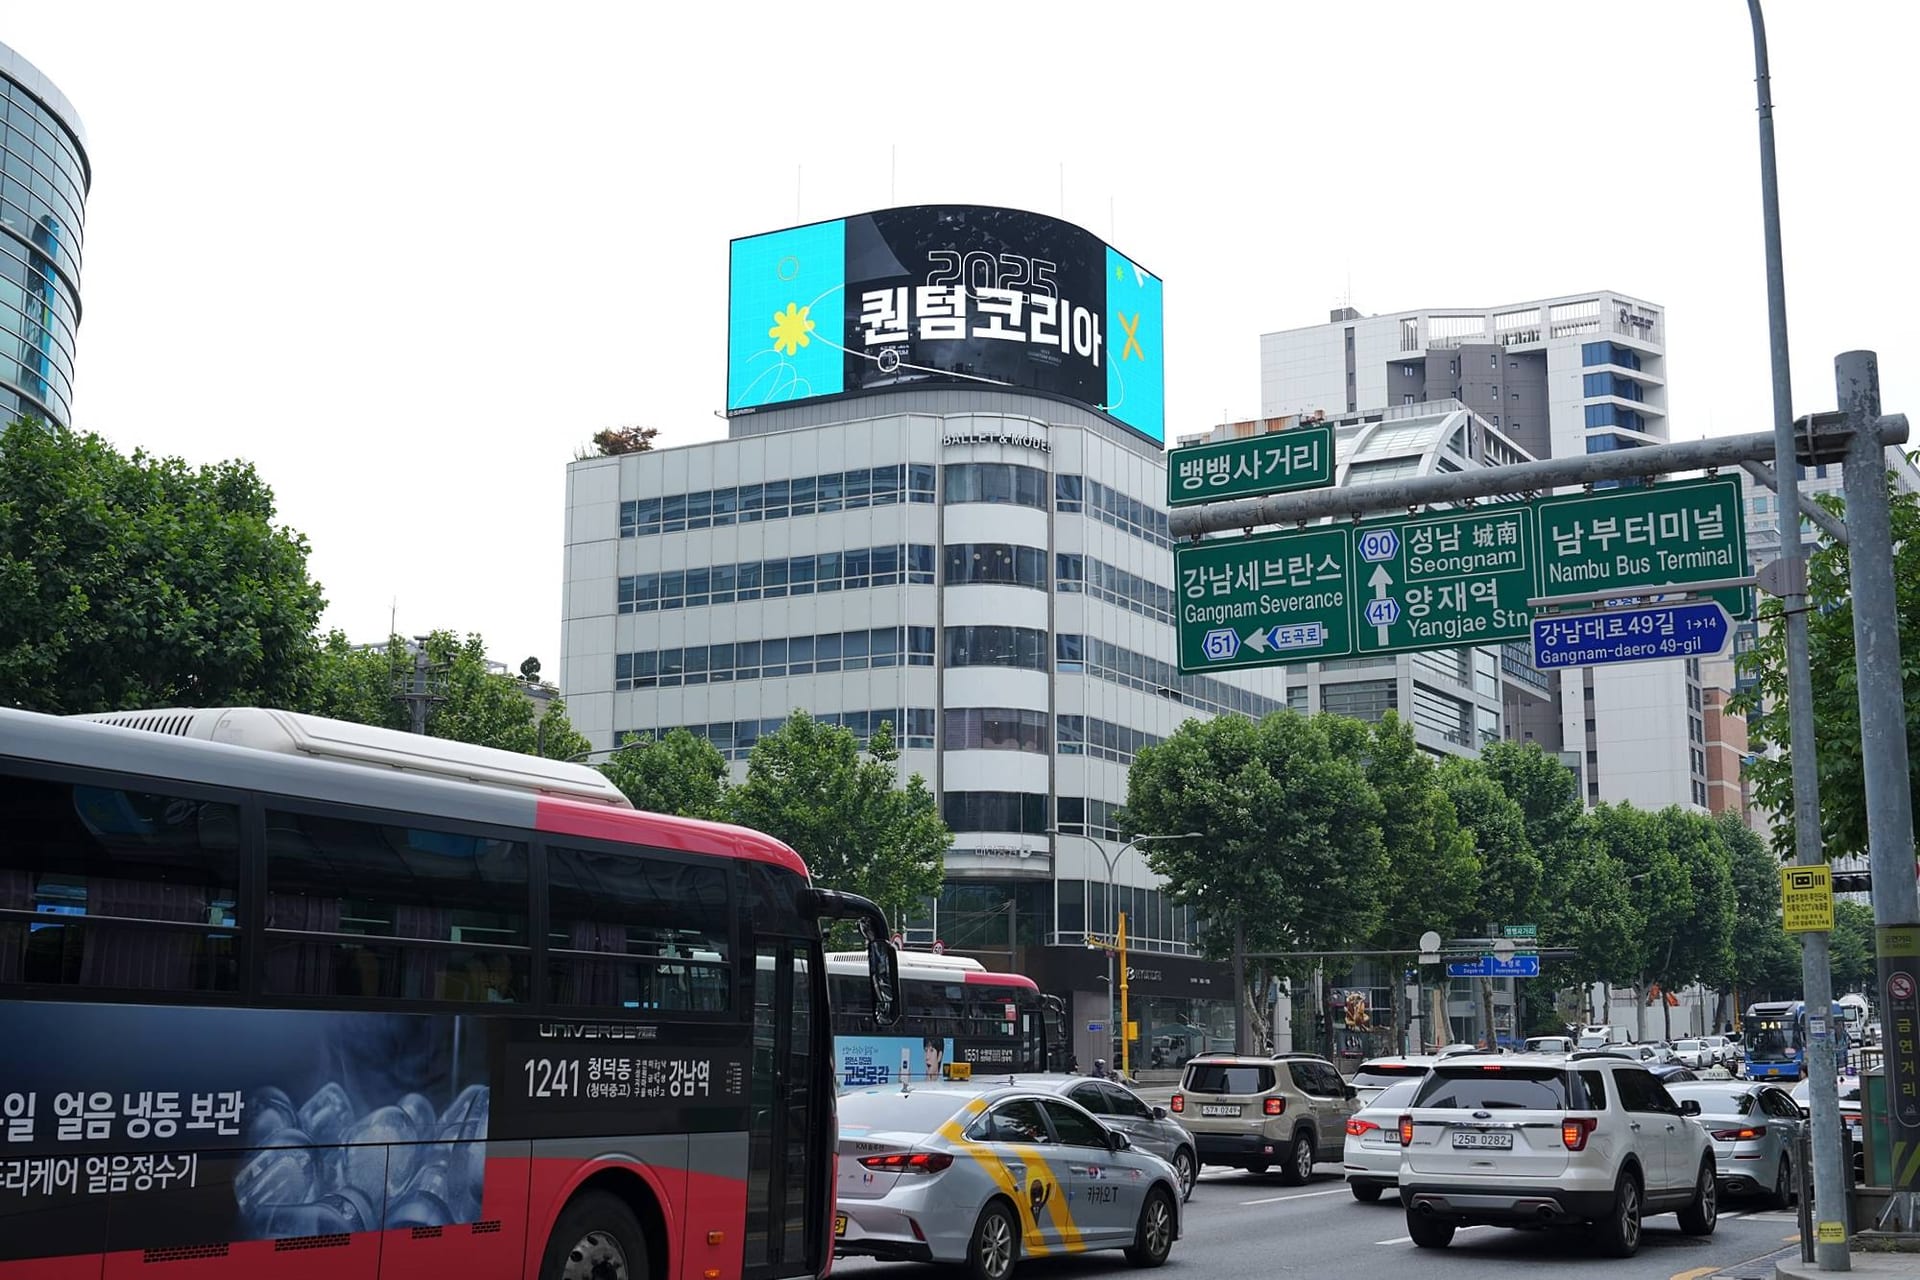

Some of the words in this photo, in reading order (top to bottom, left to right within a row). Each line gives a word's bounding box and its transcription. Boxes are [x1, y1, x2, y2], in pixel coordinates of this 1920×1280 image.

[926, 250, 1059, 304] 2025
[859, 284, 1102, 367] 퀀텀코리아
[1179, 441, 1319, 490] 뱅뱅사거리
[1367, 536, 1392, 556] 90
[1410, 523, 1461, 555] 성남
[1472, 521, 1518, 548] 城南
[1552, 503, 1725, 557] 남부터미널
[1184, 553, 1343, 598] 강남세브란스
[1410, 549, 1517, 576] Seongnam
[1549, 557, 1611, 584] Nambu
[1616, 555, 1651, 576] Bus
[1657, 543, 1734, 572] Terminal
[1184, 599, 1257, 625] Gangnam
[1260, 591, 1343, 615] Severance
[1372, 603, 1393, 620] 41
[1404, 578, 1498, 618] 양재역
[1280, 628, 1318, 644] 도곡로
[1407, 613, 1487, 639] Yangjae
[1540, 611, 1675, 647] 강남대로49길
[1210, 635, 1231, 654] 51
[1540, 643, 1656, 665] Gangnam-daero
[1660, 636, 1701, 655] 49-gil
[540, 1024, 636, 1039] UNIVERSE
[587, 1057, 632, 1082] 청덕동
[964, 1049, 979, 1062] 1551
[1896, 1018, 1917, 1097] 금연거리
[524, 1058, 580, 1098] 1241
[586, 1082, 632, 1099] (청덕중고)
[668, 1060, 710, 1097] 강남역
[0, 1092, 37, 1142] 일
[54, 1091, 116, 1141] 얼음
[122, 1091, 184, 1139] 냉동
[186, 1090, 245, 1136] 보관
[1481, 1135, 1506, 1145] 0282
[85, 1153, 198, 1194] 얼음정수기
[1087, 1185, 1119, 1205] 카카오T
